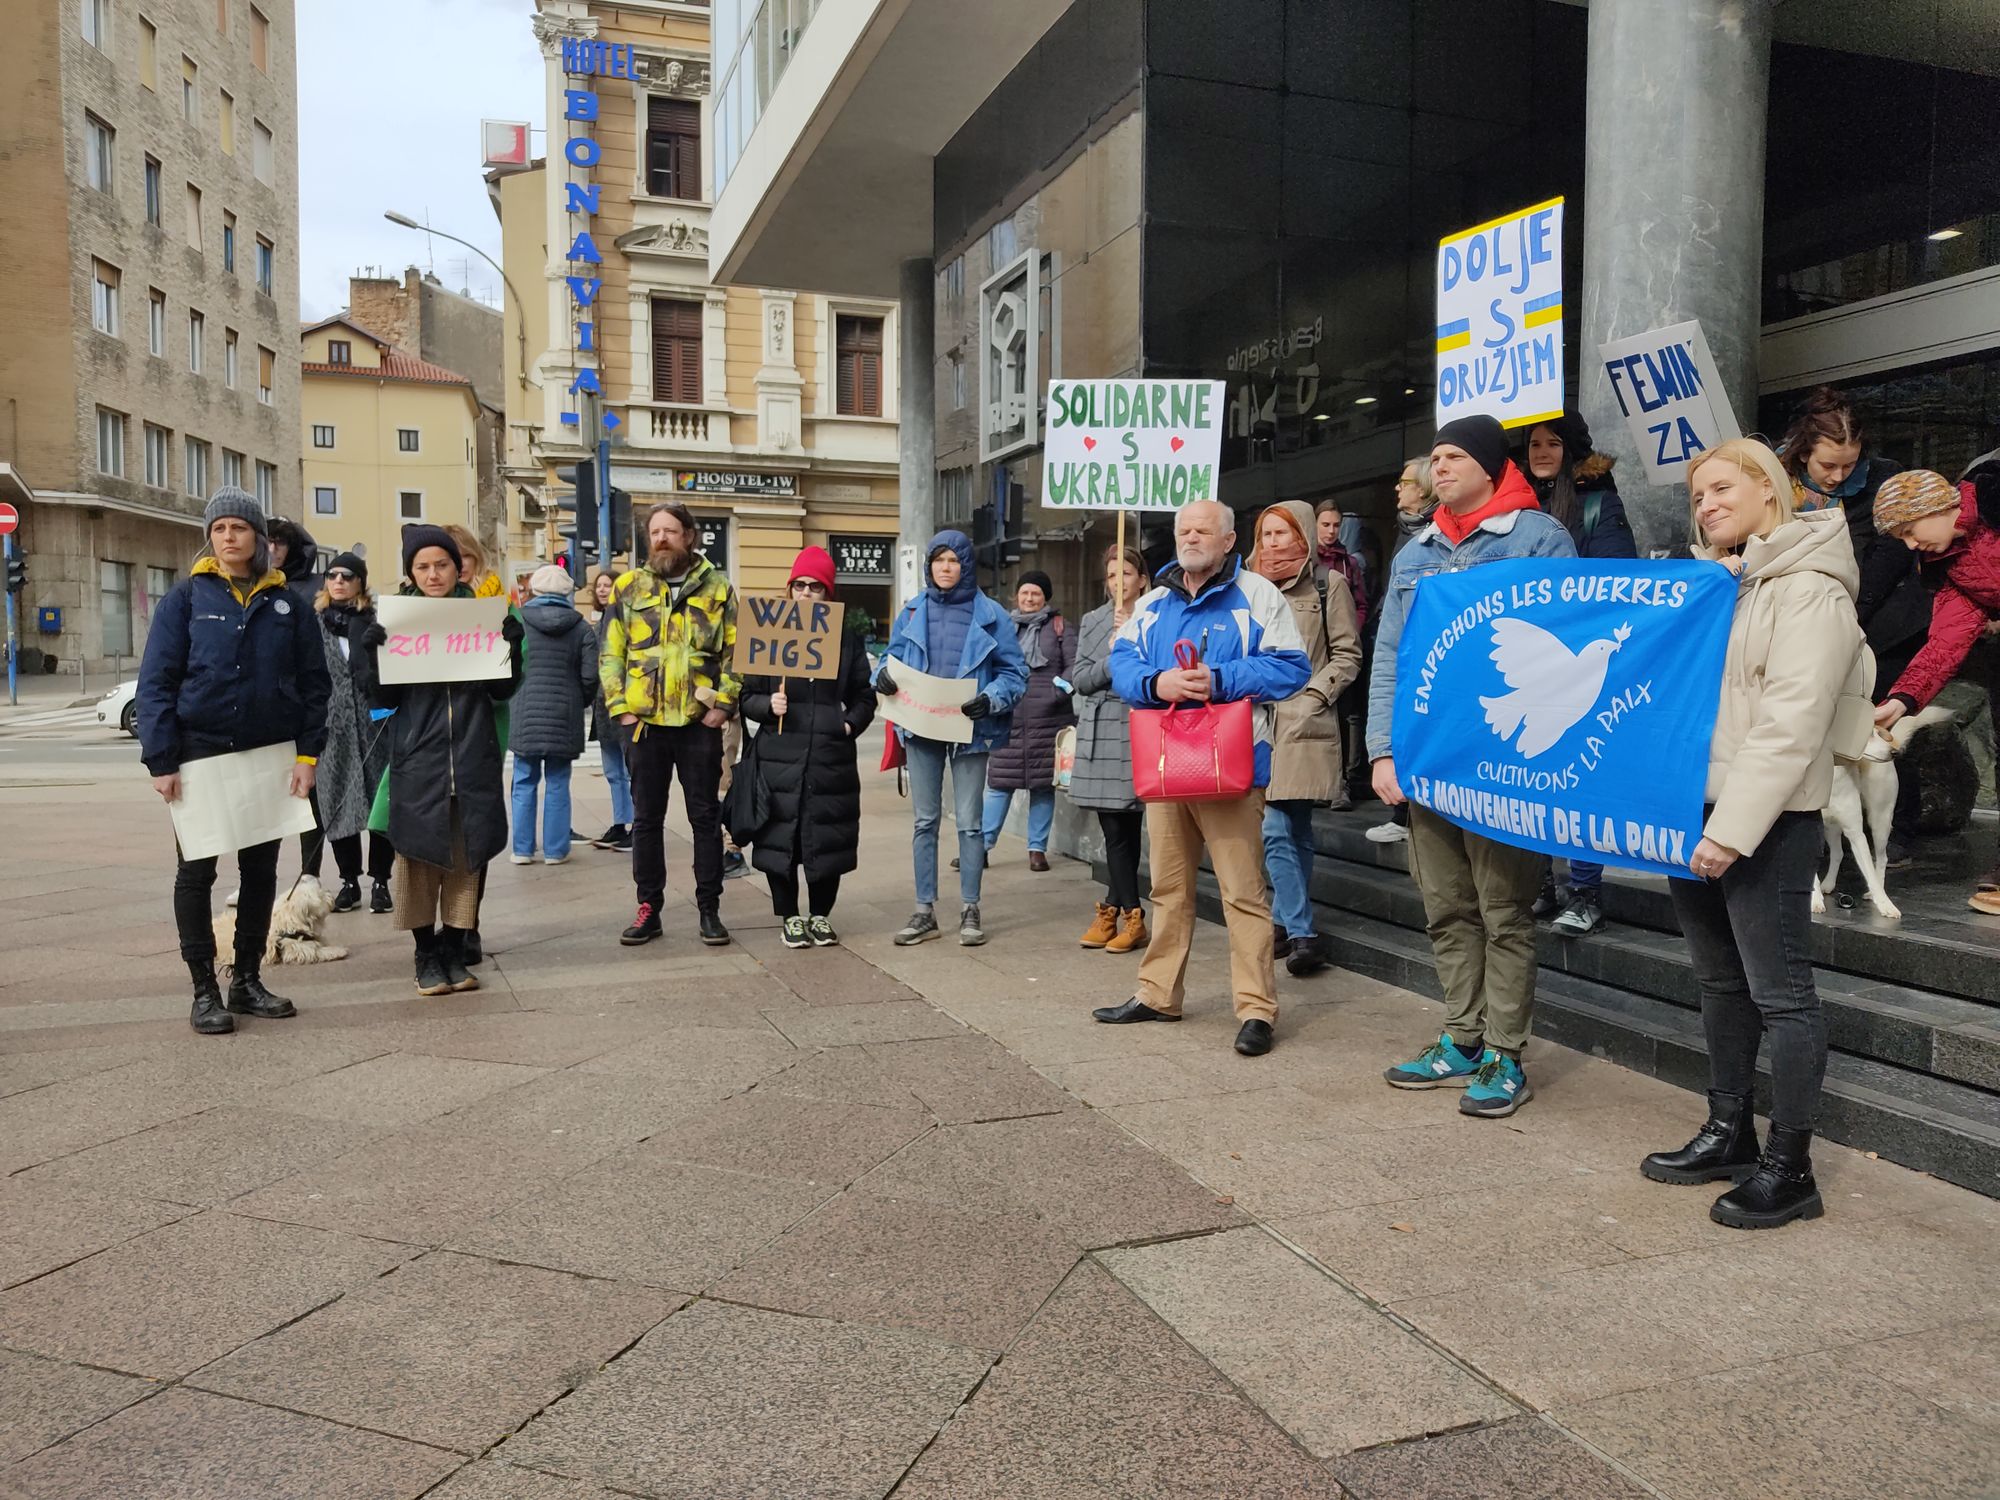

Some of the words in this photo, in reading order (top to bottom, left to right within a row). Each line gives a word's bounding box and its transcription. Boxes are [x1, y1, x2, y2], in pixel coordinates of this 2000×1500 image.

[562, 36, 640, 80] HOTEL
[564, 89, 606, 398] BONAVIA
[1443, 208, 1553, 294] DOLJE
[1483, 298, 1515, 349] S
[1439, 333, 1556, 407] ORUŽJEM
[1052, 384, 1212, 429] SOLIDARNE
[1122, 431, 1139, 462] S
[1648, 416, 1706, 466] ZA
[1049, 462, 1212, 507] UKRAJINOM
[388, 631, 430, 657] za
[446, 623, 501, 654] mir
[748, 597, 831, 634] WAR
[749, 637, 823, 670] PIGS
[1414, 590, 1505, 715] EMPECHONS
[1511, 578, 1552, 610] LES
[1560, 575, 1688, 608] GUERRES
[1477, 760, 1580, 794] CULTIVONS
[1581, 735, 1605, 772] LA
[1597, 679, 1652, 733] PAIX
[1411, 774, 1432, 808] LE
[1434, 779, 1547, 841] MOUVEMENT
[1553, 806, 1585, 848] DE
[1588, 814, 1623, 856] LA
[1626, 820, 1687, 866] PAIX
